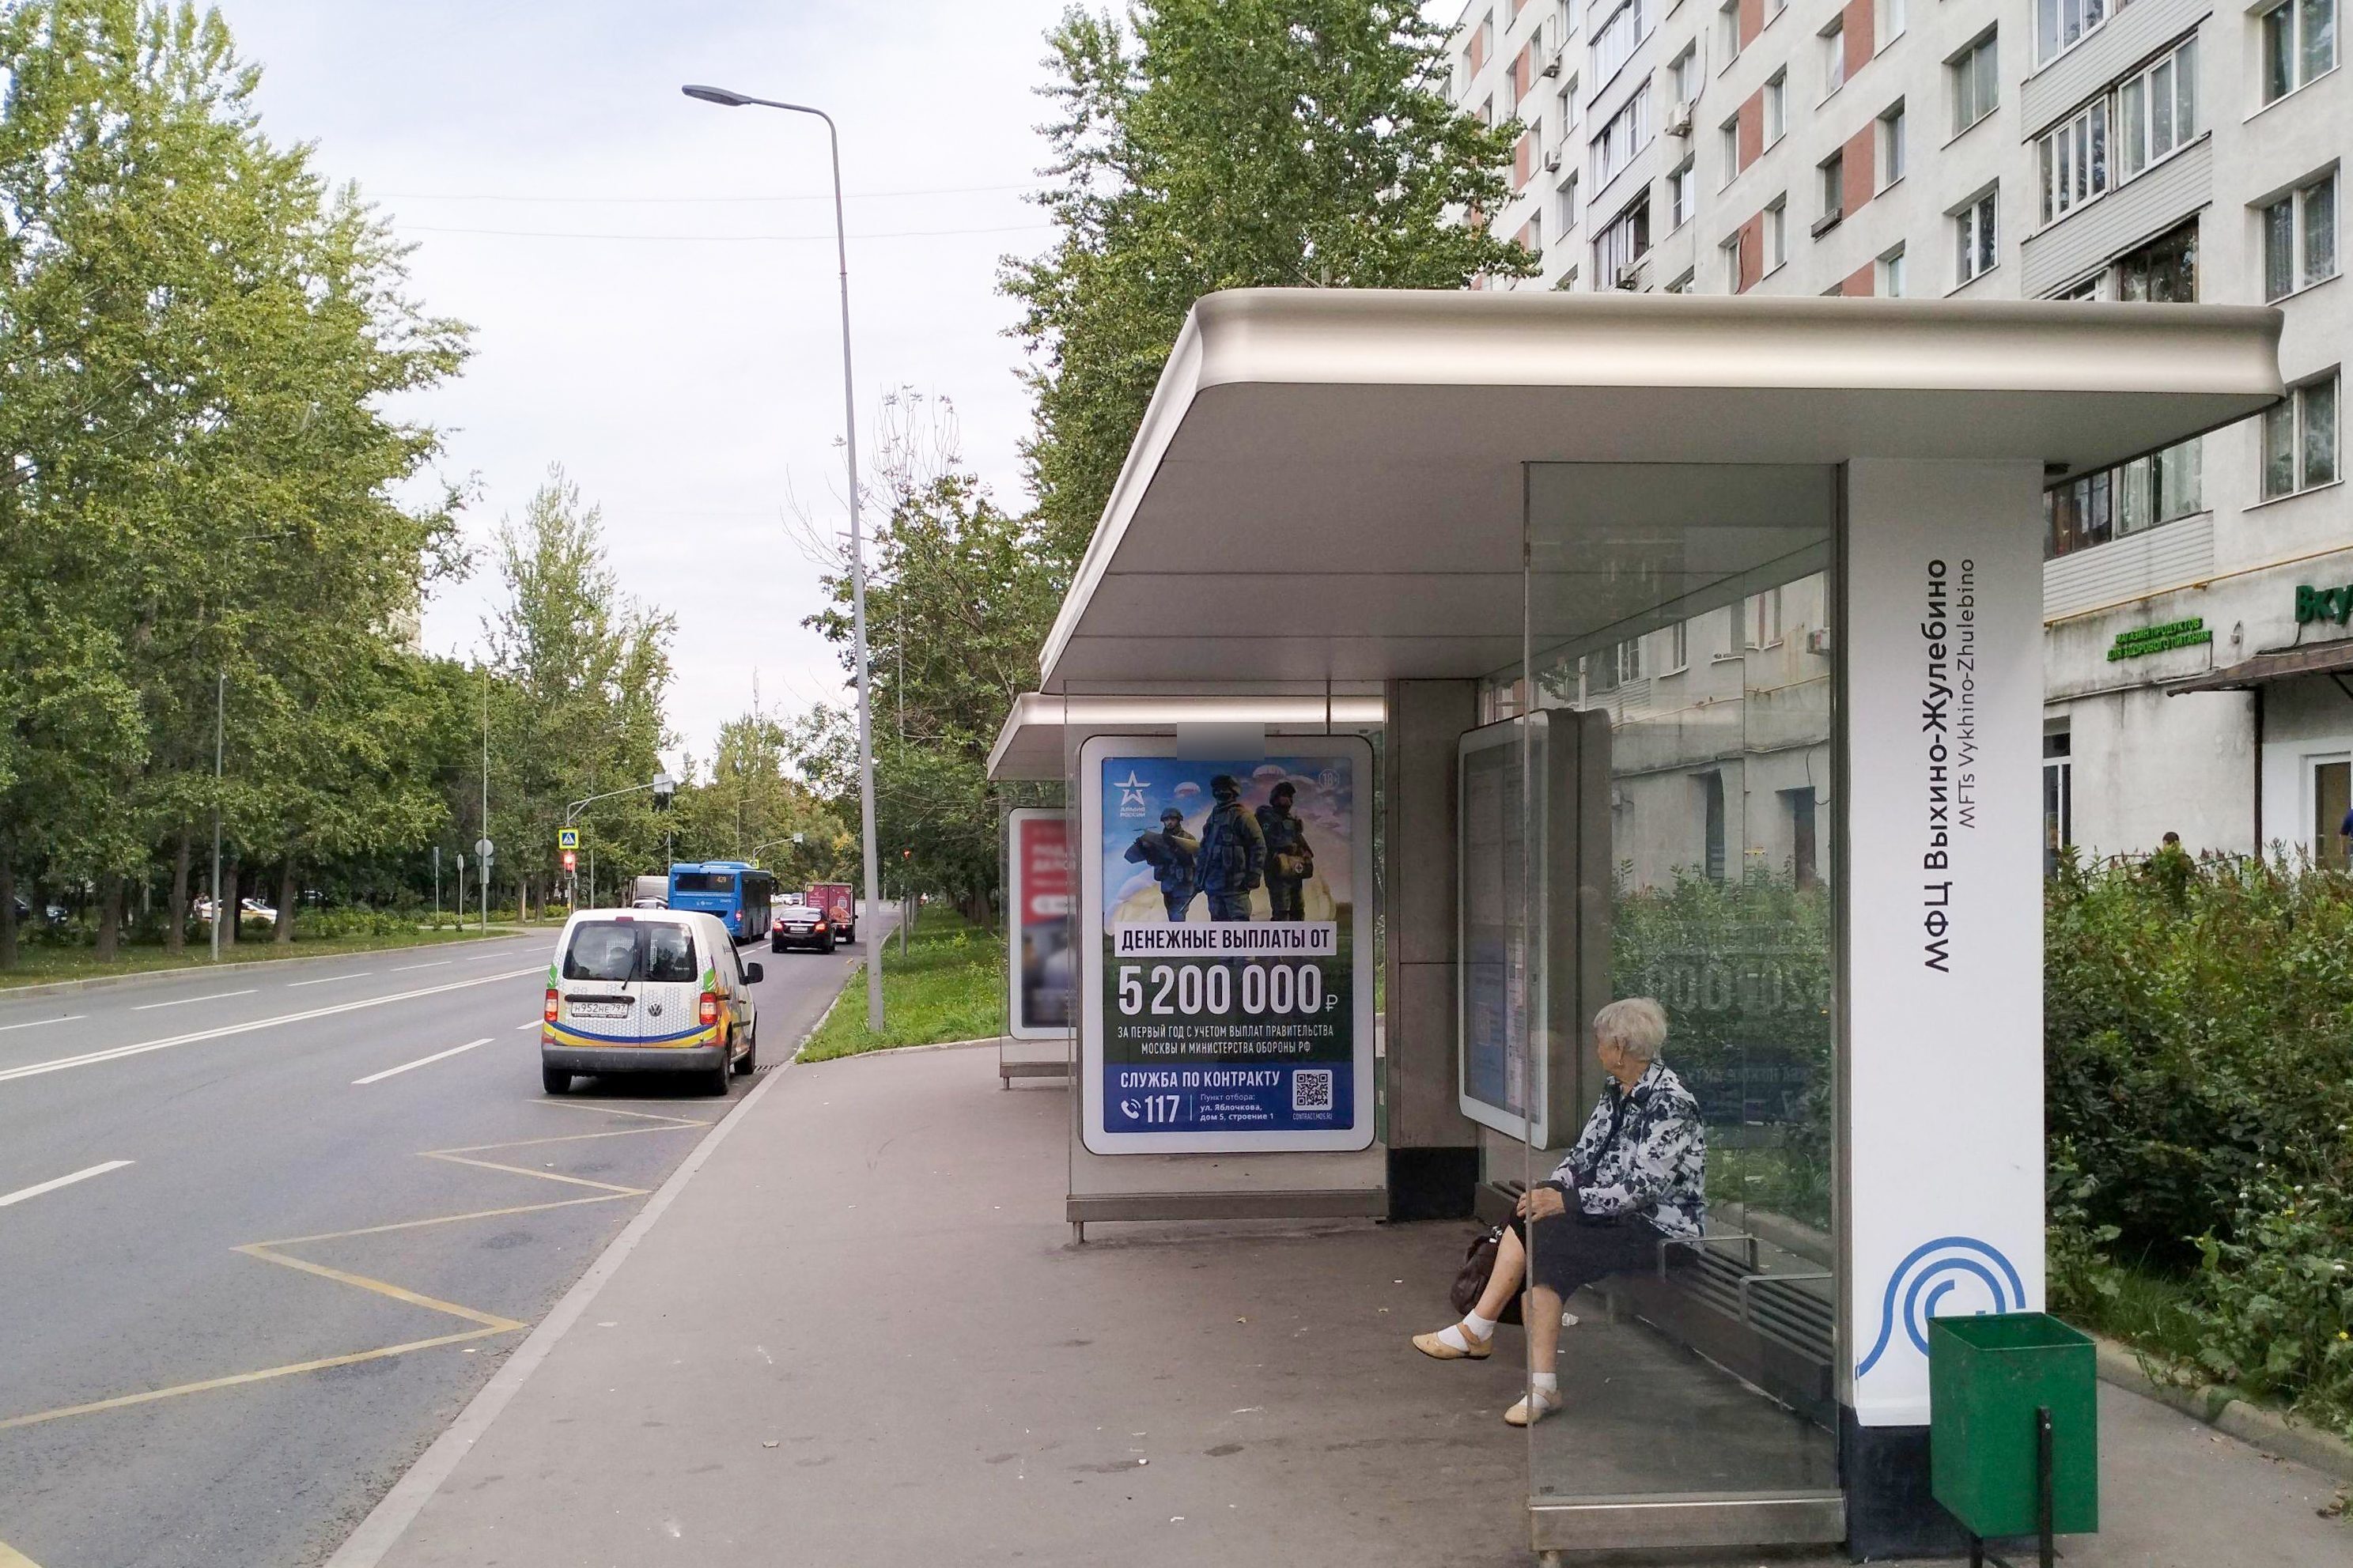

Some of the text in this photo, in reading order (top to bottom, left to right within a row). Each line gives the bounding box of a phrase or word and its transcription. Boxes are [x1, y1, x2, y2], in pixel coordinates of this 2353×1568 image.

[1957, 557, 1979, 828] MFTs Vykhino-Zhulebino
[1921, 559, 1954, 973] МФЦ Выхино-Жулебино
[1122, 928, 1330, 951] ДЕНЕЖНЫЕ ВЫПЛАТЫ ОТ
[1118, 965, 1143, 1015] 5
[1151, 965, 1231, 1014] 200
[1242, 964, 1322, 1014] 000
[1118, 1023, 1334, 1039] ЗА ПЕРВЫЙ ГОД С УЧЕТОМ ВЫПЛАТ ПРАВИТЕЛЬСТВА
[1141, 1041, 1311, 1055] МОСКВЫ И МИНИСТЕРСТВА ОБОРОНЫ РФ
[1120, 1070, 1281, 1088] СЛУЖБА ПО КОНТРАКТУ
[1200, 1093, 1256, 1102] Пункт отбора:
[1144, 1094, 1181, 1124] 117
[1200, 1114, 1218, 1123] дом
[1228, 1113, 1269, 1123] строение
